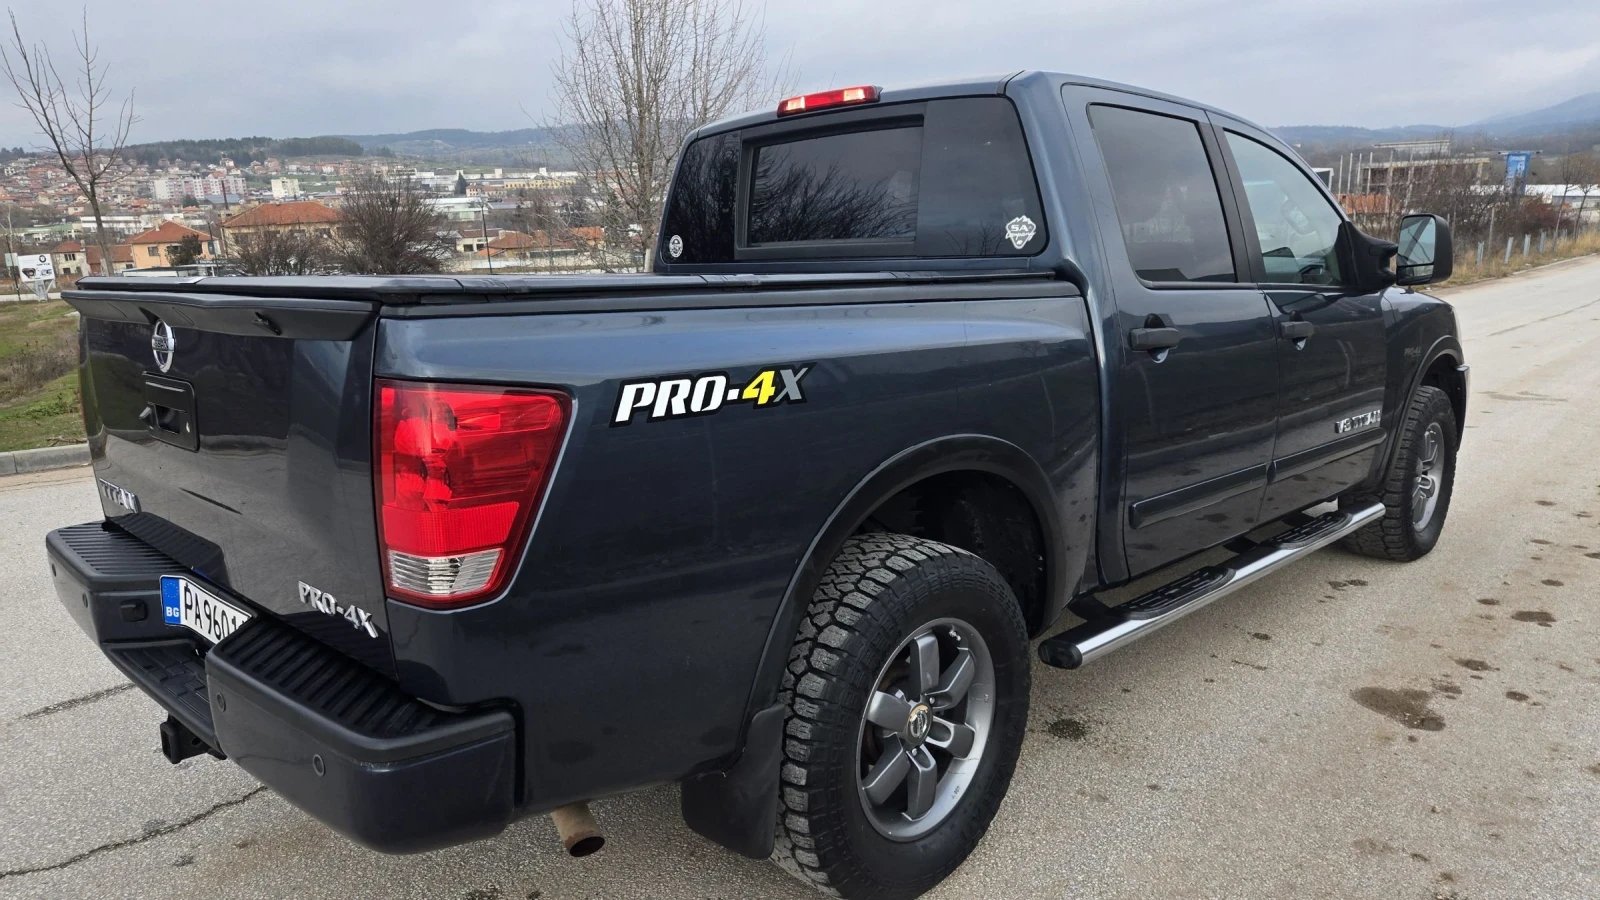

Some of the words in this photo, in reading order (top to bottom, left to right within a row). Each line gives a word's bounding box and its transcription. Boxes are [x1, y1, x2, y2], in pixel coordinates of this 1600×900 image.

[615, 367, 809, 422] PRO-4X
[166, 606, 179, 617] BG
[299, 580, 379, 638] PRO-4X
